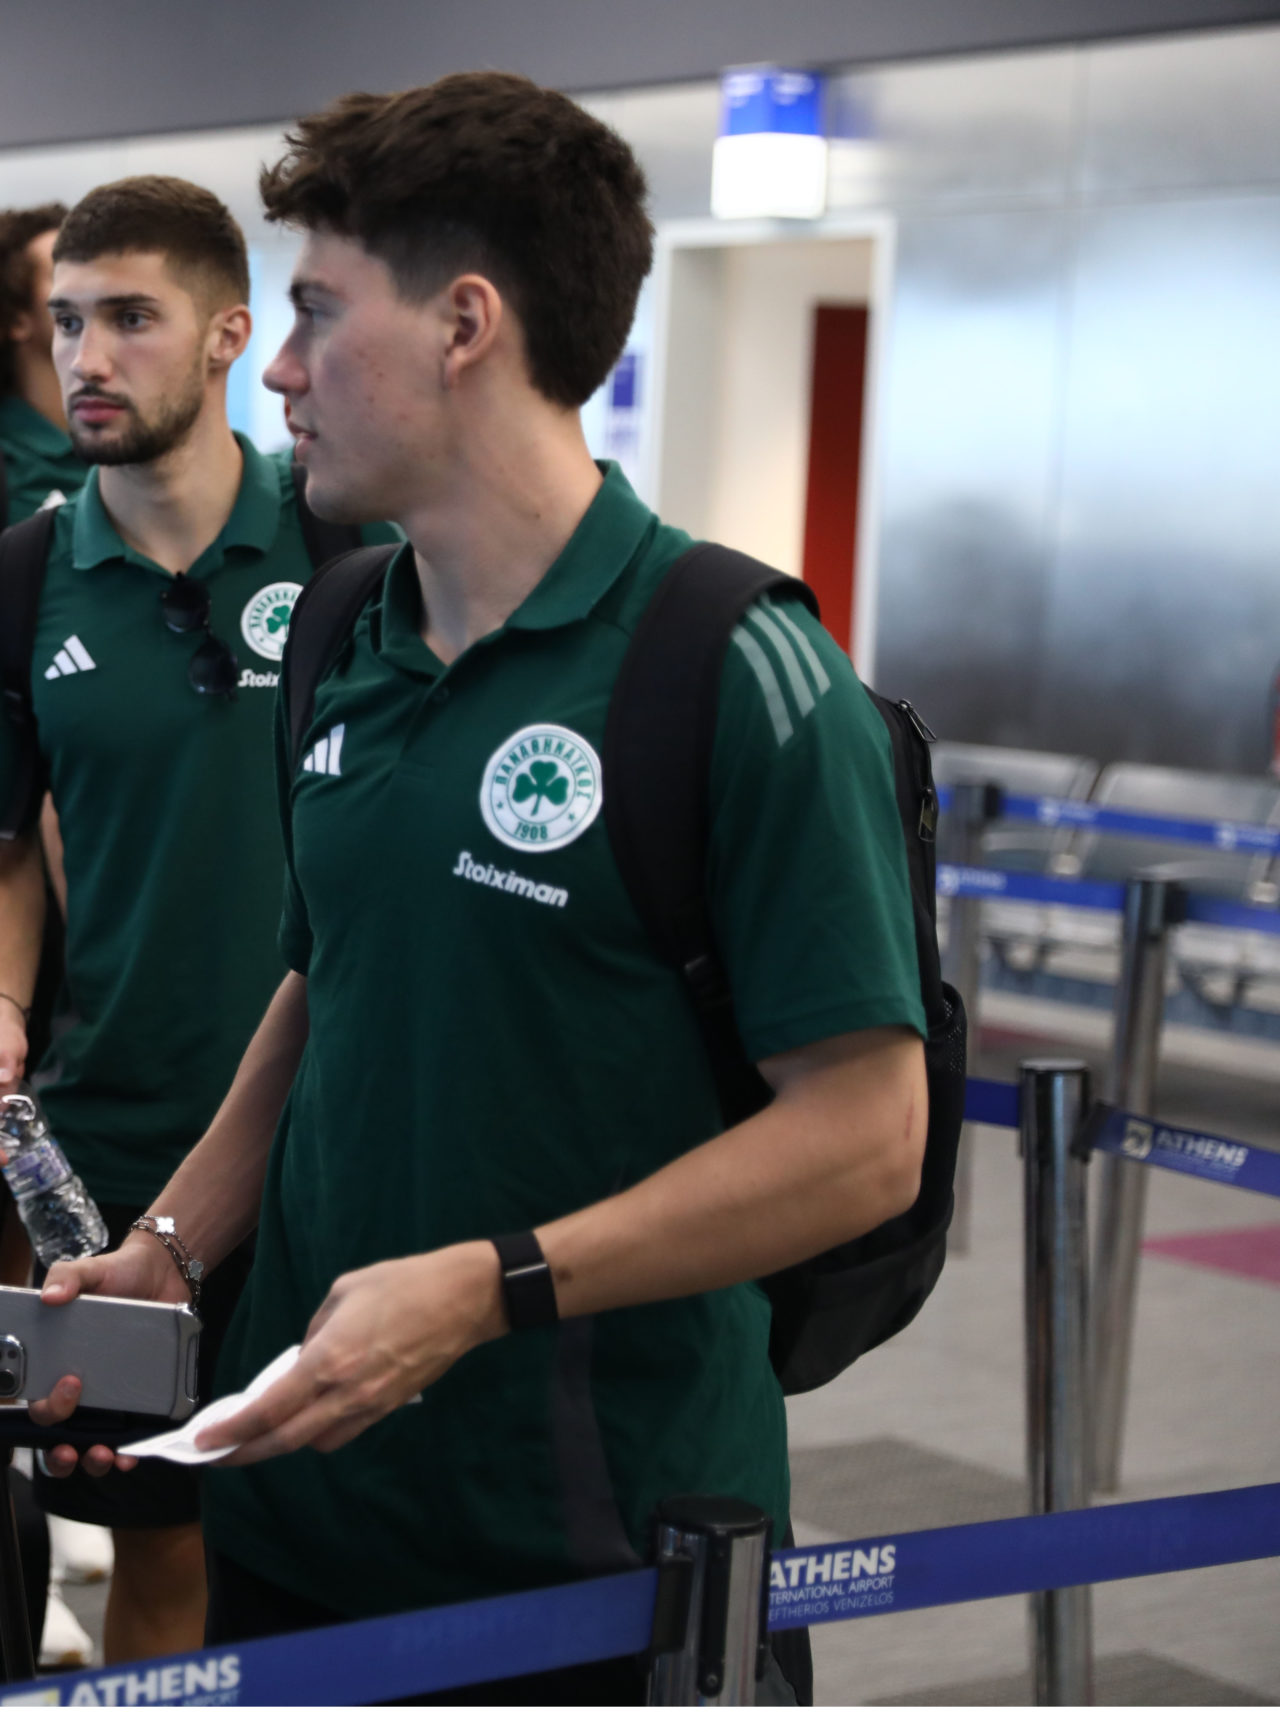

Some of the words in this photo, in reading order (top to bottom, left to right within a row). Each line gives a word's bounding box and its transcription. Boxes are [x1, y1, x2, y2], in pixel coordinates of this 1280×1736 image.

[514, 822, 549, 841] 1908
[452, 851, 569, 908] Stoiximan
[1153, 1127, 1249, 1167] ATHENS
[847, 1575, 895, 1594] AIRPORT
[833, 1591, 894, 1612] VENIZELOS
[68, 1655, 240, 1706] ATHENS
